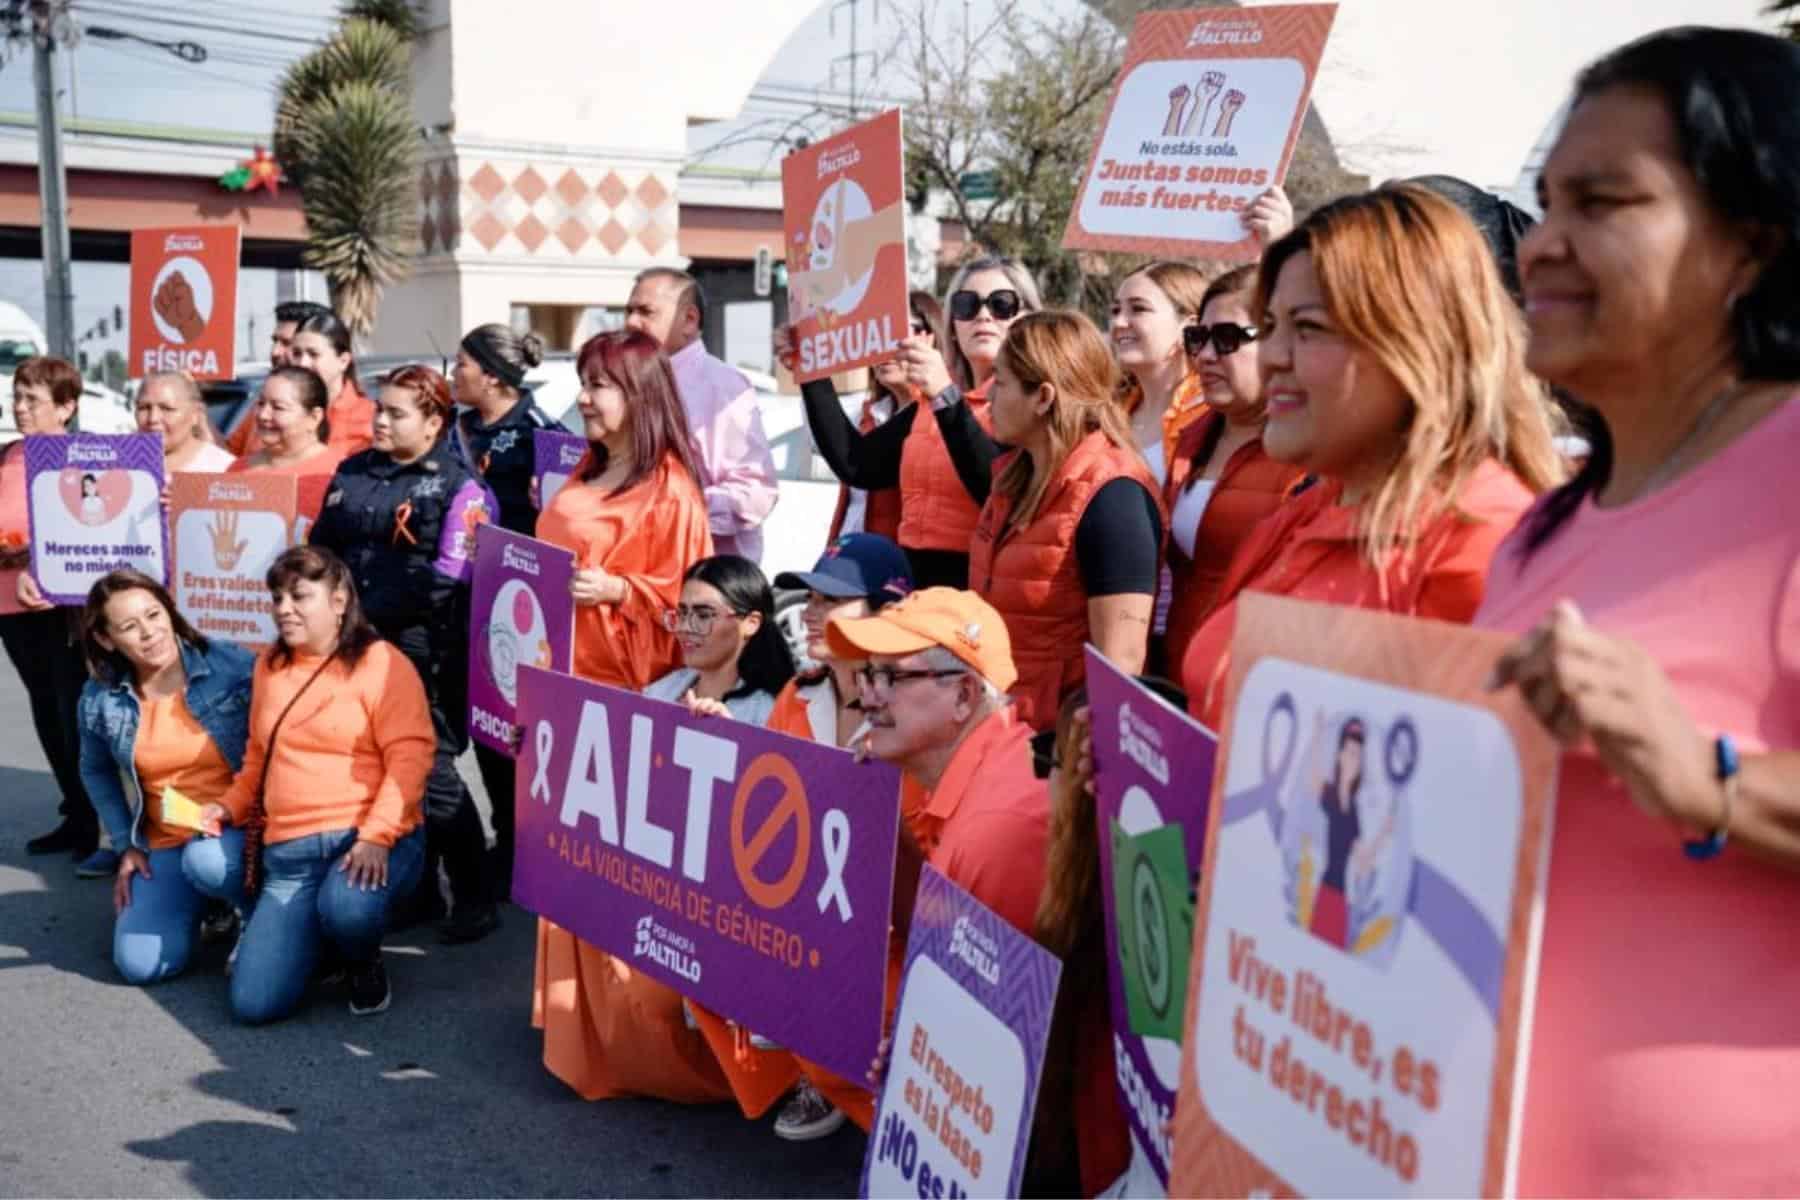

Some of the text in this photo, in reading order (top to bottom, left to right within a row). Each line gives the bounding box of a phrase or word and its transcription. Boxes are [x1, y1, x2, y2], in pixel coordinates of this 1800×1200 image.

[1139, 140, 1239, 157] No estás sola.
[1097, 159, 1268, 186] Juntas somos
[1099, 183, 1148, 207] más
[143, 344, 219, 374] FÍSICA
[800, 314, 899, 374] SEXUAL
[44, 541, 109, 556] Mereces
[64, 561, 84, 573] no
[183, 571, 216, 590] Eres
[197, 613, 262, 635] siempre.
[471, 705, 513, 743] PSICO
[560, 832, 803, 969] A LA VIOLENCIA DE GÉNERO
[1228, 928, 1441, 1113] Vive libre, es
[910, 1022, 929, 1067] El
[925, 1047, 993, 1136] respeto
[1232, 1003, 1420, 1184] tu derecho
[904, 1076, 982, 1180] es la base
[878, 1110, 918, 1182] ¡NO
